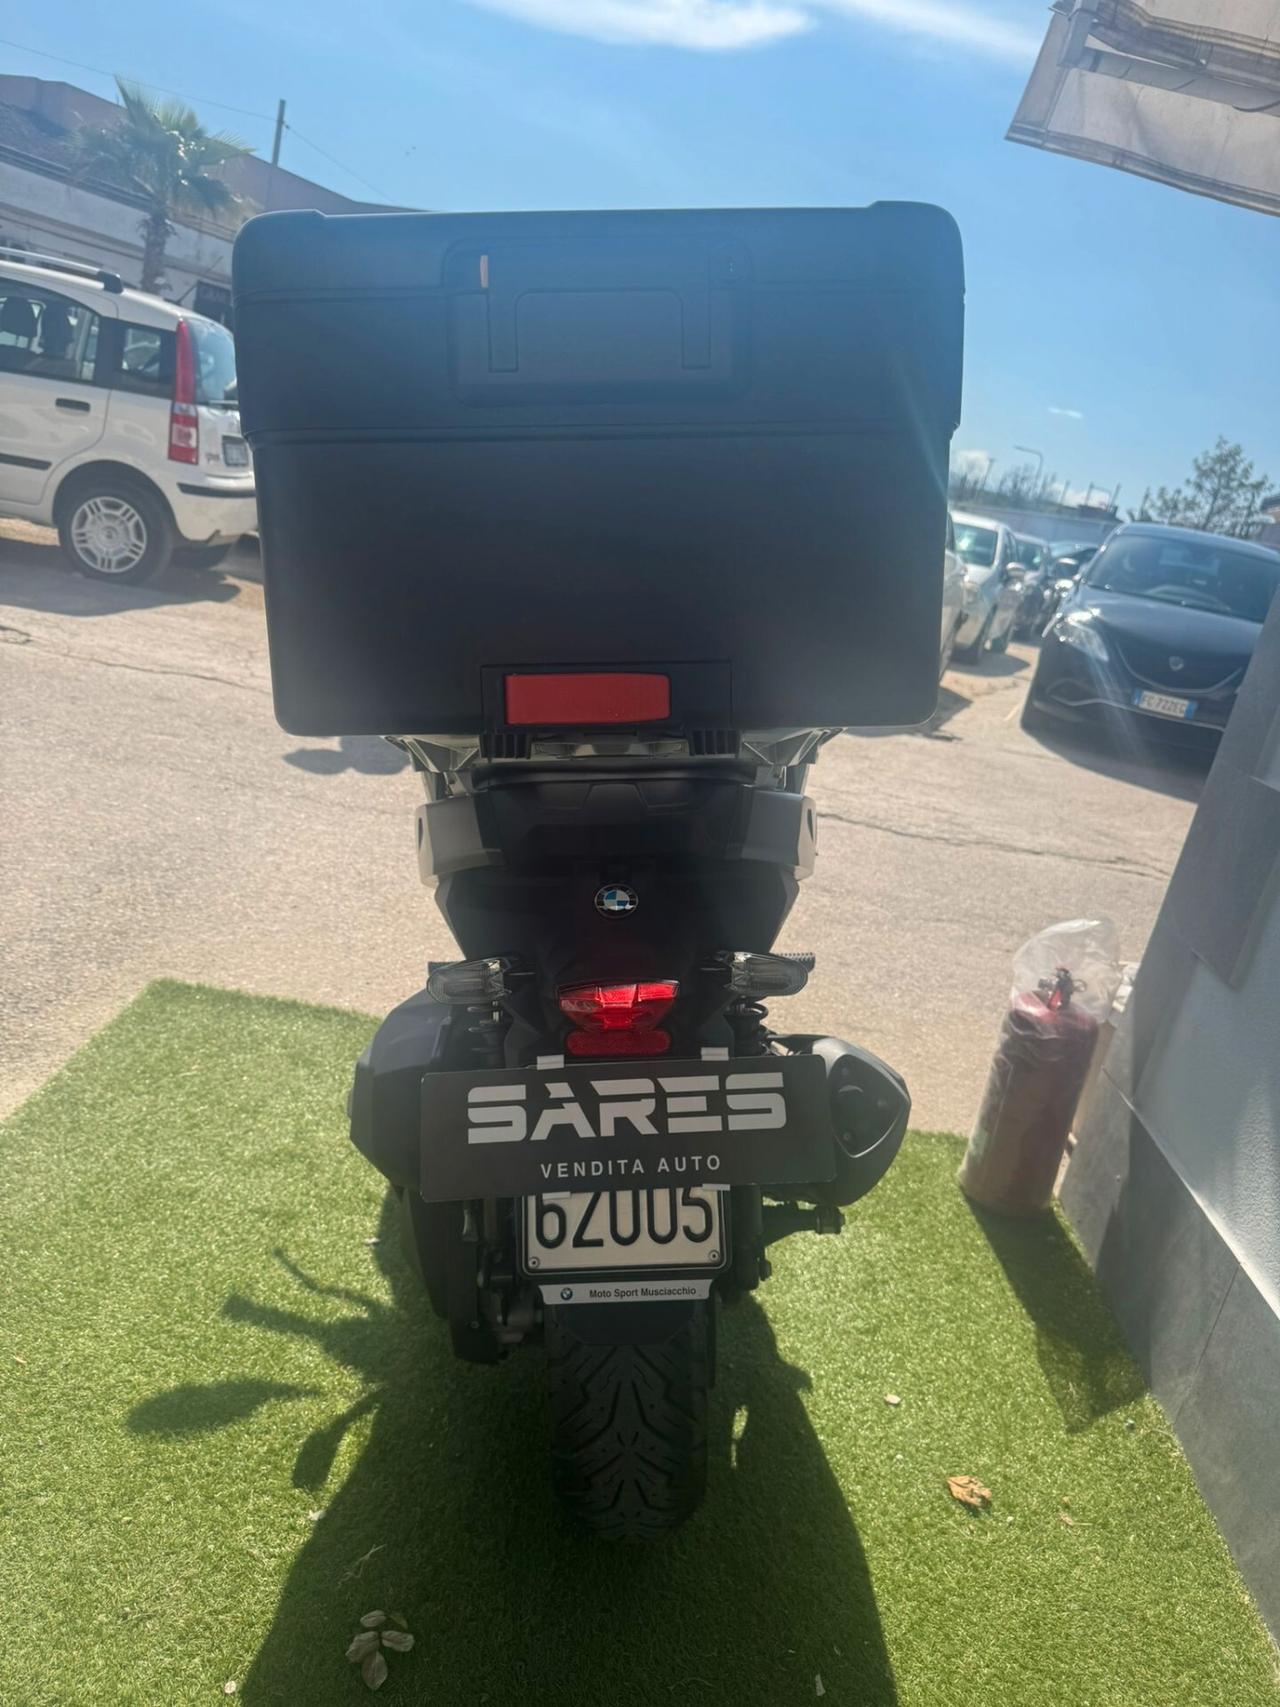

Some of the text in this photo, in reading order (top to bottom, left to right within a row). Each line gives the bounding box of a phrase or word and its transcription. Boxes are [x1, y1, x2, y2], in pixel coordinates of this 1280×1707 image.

[467, 1072, 787, 1145] SARES
[540, 1154, 721, 1179] VENDITA AUTO
[589, 1286, 697, 1300] Moto Sport Musciacchio
